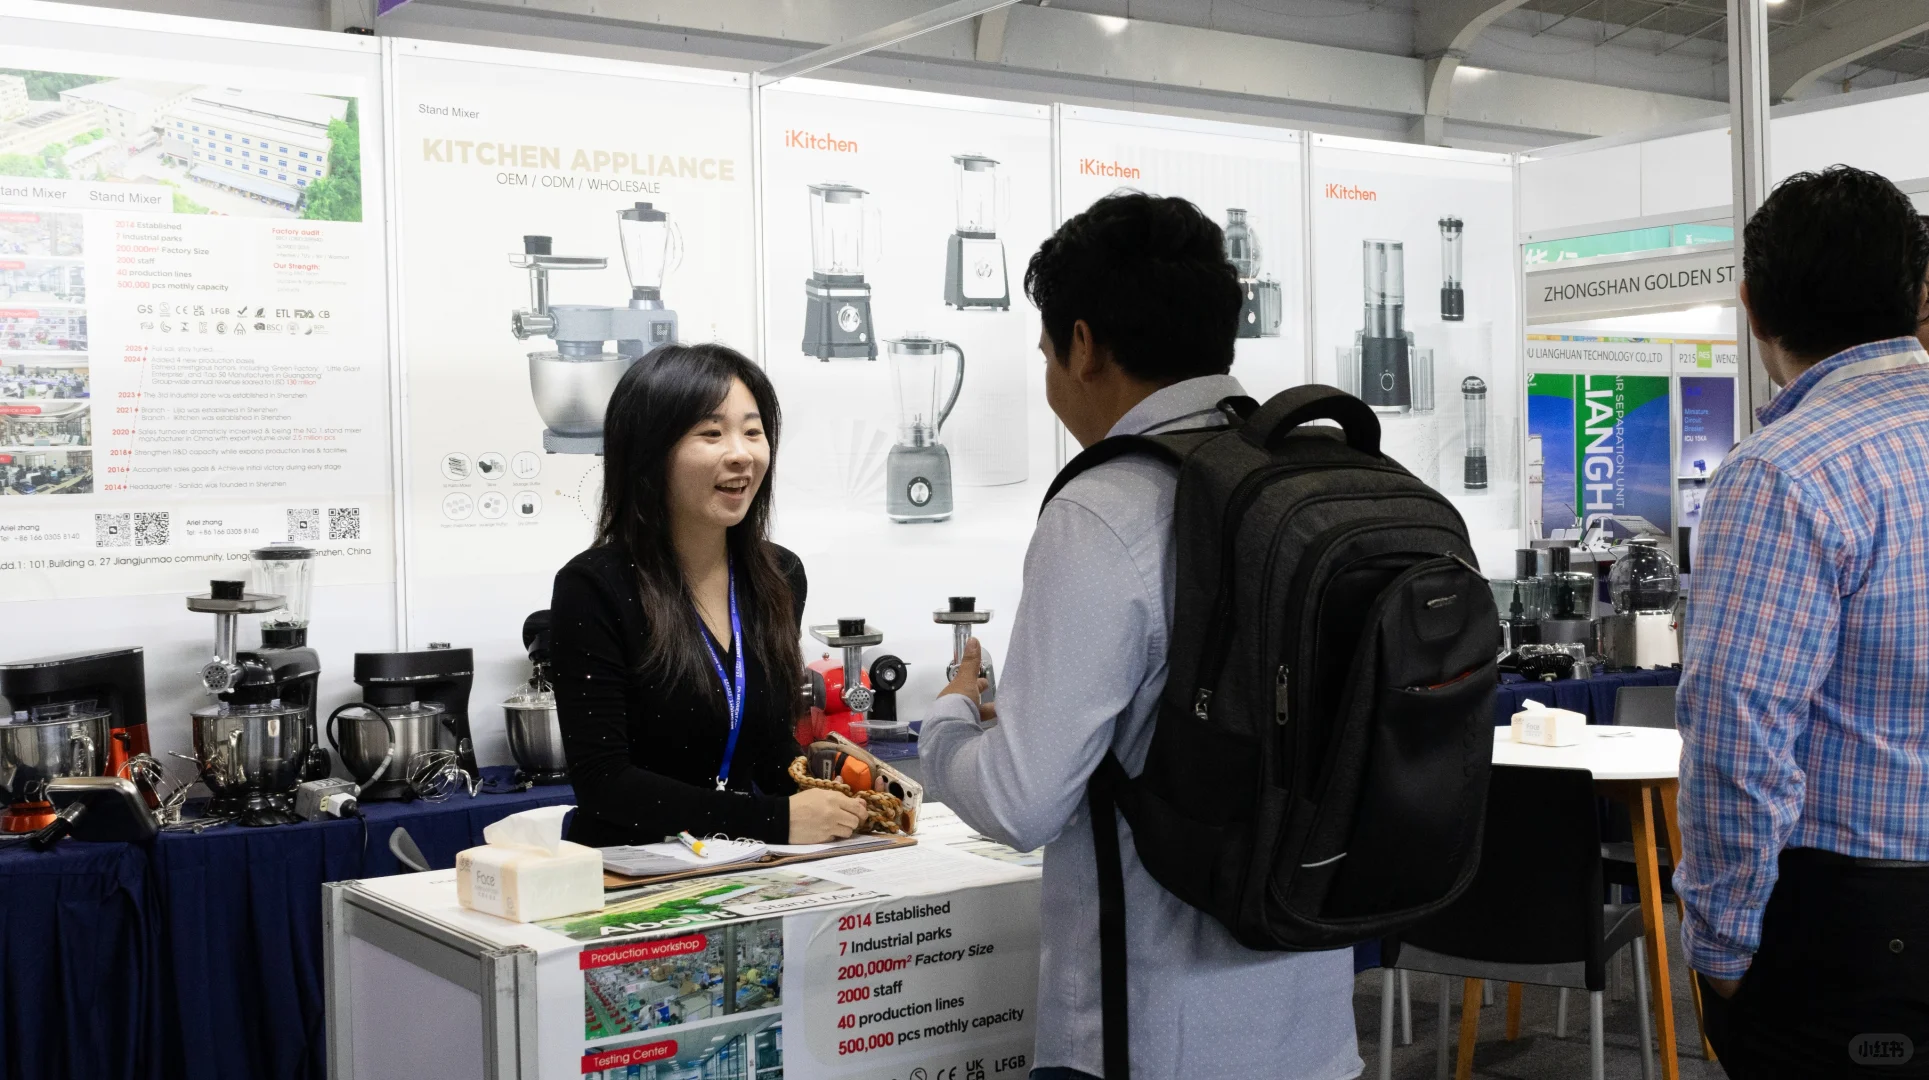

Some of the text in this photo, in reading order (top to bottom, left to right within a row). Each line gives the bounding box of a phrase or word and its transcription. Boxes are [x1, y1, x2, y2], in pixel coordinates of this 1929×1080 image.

[418, 103, 480, 119] Stand Mixer
[785, 129, 858, 154] iKitchen
[422, 138, 735, 181] KITCHEN APPLIANCE
[1080, 158, 1140, 179] iKitchen
[496, 172, 528, 186] OEM
[541, 175, 575, 189] ODM
[587, 178, 661, 194] WHOLESALE
[0, 186, 67, 199] tand Mixer
[89, 190, 162, 205] Stand Mixer
[1325, 183, 1377, 201] iKitchen
[115, 220, 182, 230] 2014 Established
[272, 228, 299, 236] Factory
[161, 246, 191, 255] Factory
[116, 256, 155, 265] 2000 staff
[129, 269, 173, 277] production
[174, 270, 192, 278] lines
[167, 282, 195, 291] mothly
[1544, 265, 1736, 302] ZHONGSHAN GOLDEN ST
[137, 304, 153, 315] GS
[211, 307, 230, 315] LFGB
[275, 309, 291, 318] ETL
[293, 309, 315, 319] FDA
[318, 310, 331, 319] CB
[1536, 348, 1583, 361] LIANGHUAN
[1583, 349, 1634, 362] TECHNOLOGY
[1679, 353, 1697, 364] P215
[1615, 393, 1625, 475] SEPARATION
[189, 449, 219, 457] capacity
[132, 466, 172, 474] Accomplish
[285, 464, 306, 472] during
[1615, 477, 1625, 509] UNIT
[17, 524, 40, 532] zhang
[202, 519, 223, 528] zhang
[63, 532, 80, 540] 8140
[346, 547, 372, 556] China
[99, 557, 111, 566] 27
[113, 556, 172, 566] Jiangjunmao
[476, 870, 495, 887] Face
[600, 909, 737, 936] About
[838, 900, 951, 932] 2014 Established
[839, 926, 952, 957] 7 Industrial parks
[590, 940, 700, 963] Production workshop
[915, 948, 965, 966] Factory
[967, 943, 995, 957] Size
[837, 980, 903, 1004] 2000 staff
[837, 996, 965, 1030] 40 production lines
[838, 1008, 1024, 1056] 500,000 pcs mothly capacity
[594, 1045, 668, 1068] Testing Center
[994, 1054, 1026, 1073] LFGB
[966, 1058, 984, 1071] UK
